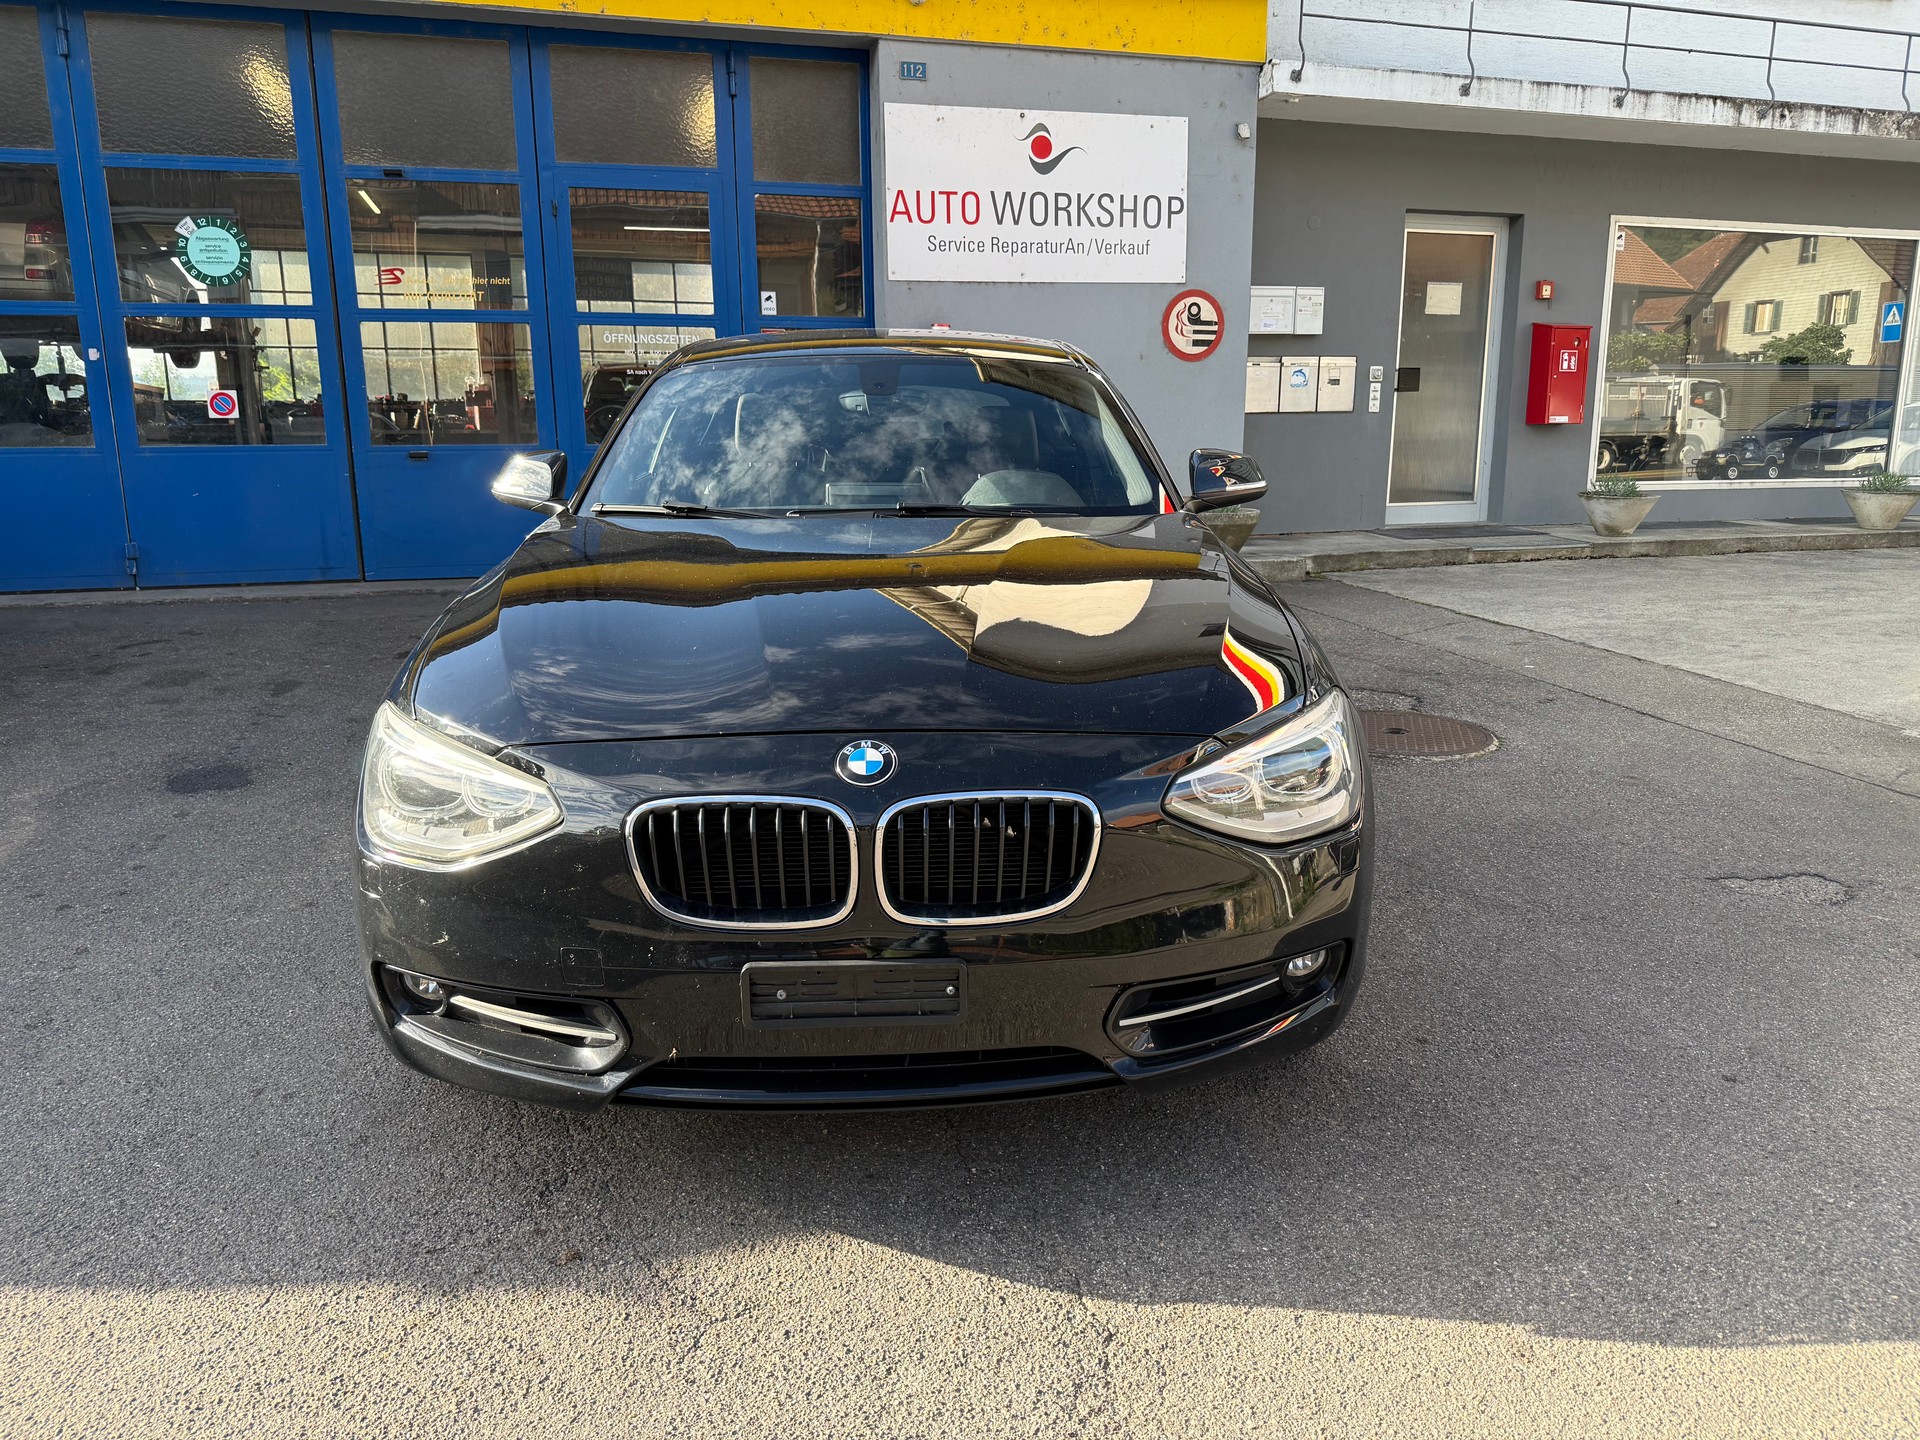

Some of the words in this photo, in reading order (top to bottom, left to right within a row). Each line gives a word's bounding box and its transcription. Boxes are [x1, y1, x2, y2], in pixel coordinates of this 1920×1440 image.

[902, 64, 924, 78] 112
[889, 189, 981, 225] AUTO
[990, 190, 1185, 229] WORKSHOP
[196, 218, 207, 226] 12
[230, 227, 237, 235] 2
[178, 238, 186, 247] 10
[927, 235, 985, 253] Service
[990, 236, 1150, 257] ReparaturAn/Verkauf
[235, 269, 243, 277] 5
[490, 277, 511, 285] nicht
[603, 331, 700, 345] ÖFFNUNGSZEITEN
[843, 740, 890, 755] BMW
